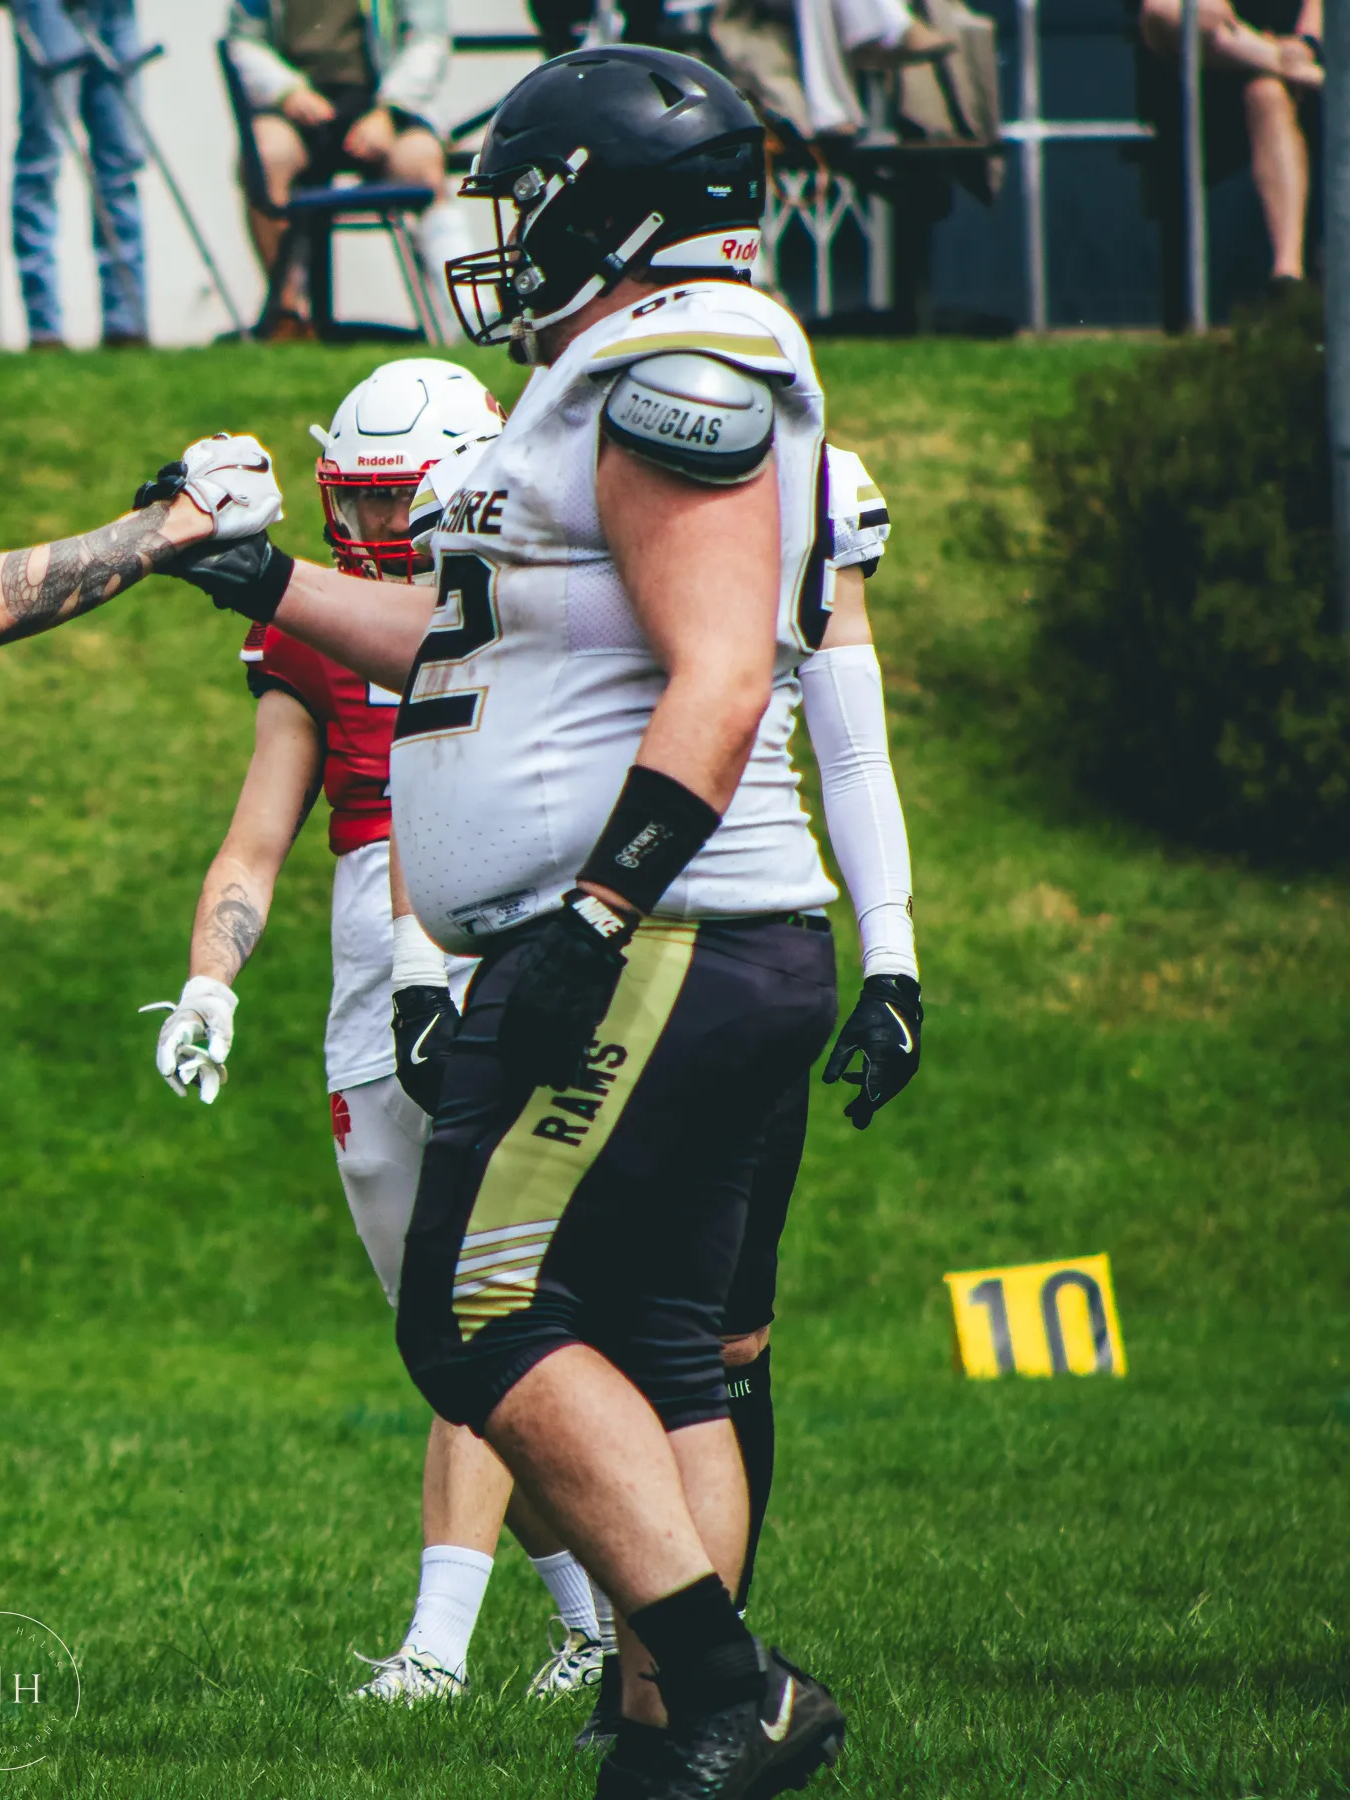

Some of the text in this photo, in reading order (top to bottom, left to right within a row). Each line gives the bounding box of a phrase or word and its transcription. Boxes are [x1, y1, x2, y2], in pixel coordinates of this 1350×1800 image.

[620, 393, 722, 446] DOUGLAS
[357, 454, 404, 467] Riddell
[571, 896, 626, 938] NIKE
[531, 1040, 628, 1148] RAMS
[969, 1269, 1114, 1375] 10
